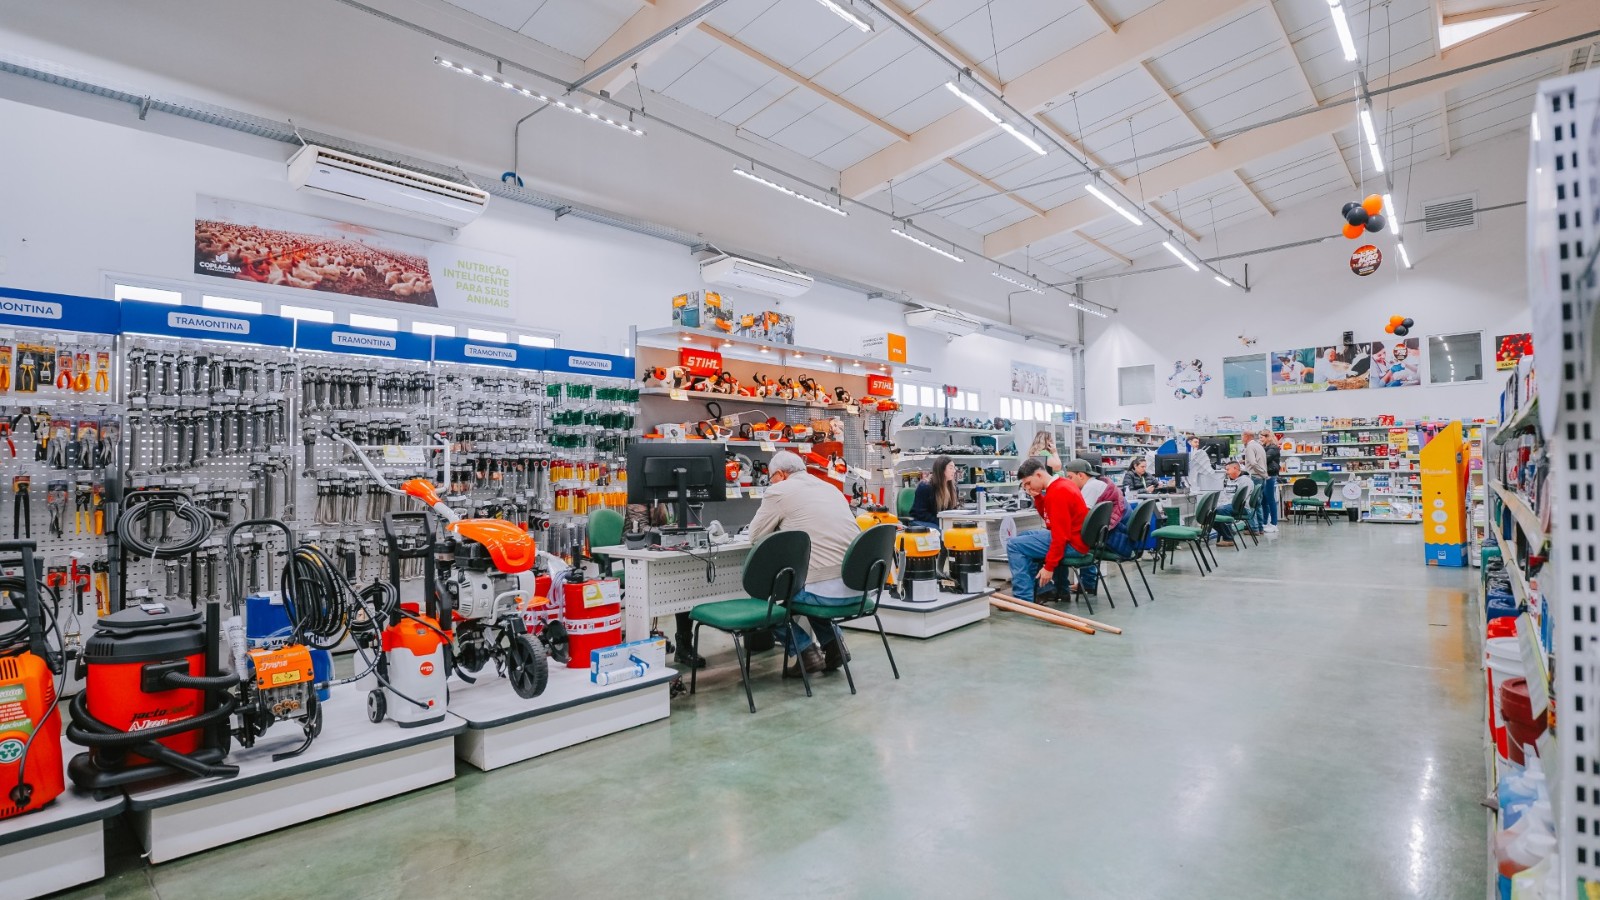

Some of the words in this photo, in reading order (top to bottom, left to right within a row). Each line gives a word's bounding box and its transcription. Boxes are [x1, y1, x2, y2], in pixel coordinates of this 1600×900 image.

[199, 261, 242, 273] COPLACANA
[457, 260, 509, 277] NUTRIÇÃO
[443, 267, 509, 287] INTELIGENTE
[456, 281, 483, 294] PARA
[484, 287, 509, 298] SEUS
[467, 294, 509, 308] ANIMAIS
[0, 302, 54, 315] ONTINA
[175, 316, 244, 331] TRAMONTINA
[337, 335, 391, 348] TRAMONTINA
[469, 347, 513, 359] TRAMONTINA
[571, 358, 609, 368] TRAMONTINA
[687, 356, 720, 370] STIHL
[873, 380, 893, 391] STIHL
